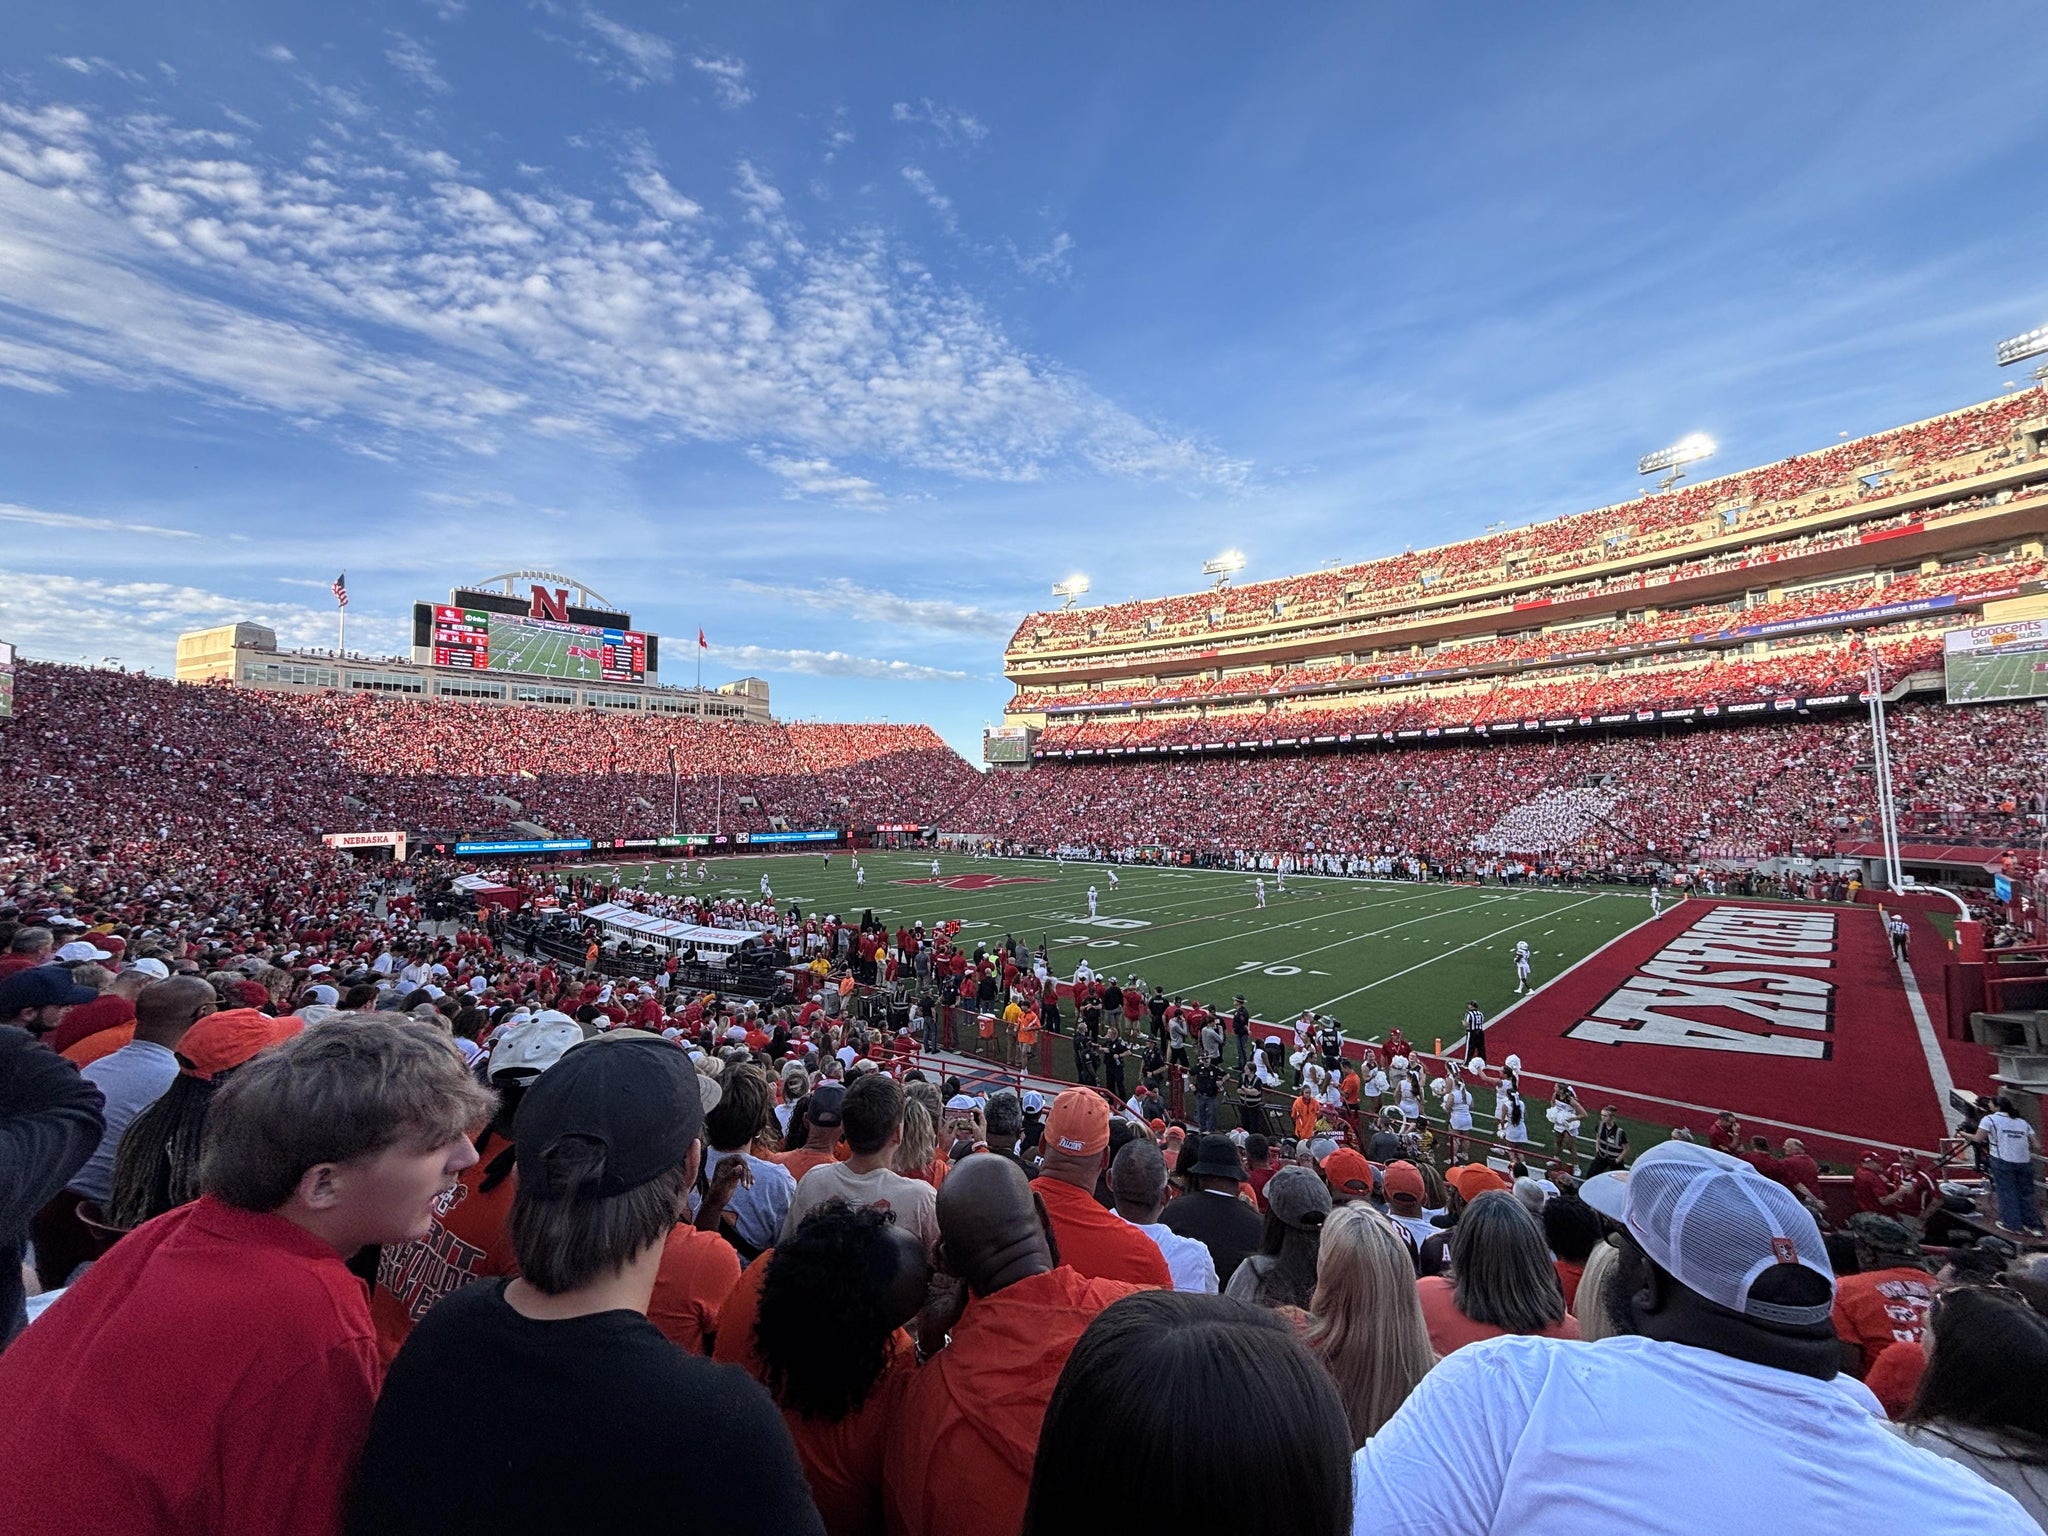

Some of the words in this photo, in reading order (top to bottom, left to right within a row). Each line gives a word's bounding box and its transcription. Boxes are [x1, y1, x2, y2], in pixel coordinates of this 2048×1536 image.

[1551, 592, 1590, 604] NATION
[1594, 582, 1641, 597] LEADING
[1676, 562, 1742, 580] ACADEMIC
[1748, 556, 1771, 567] ALL
[1777, 538, 1861, 561] AMERICANS
[529, 584, 569, 622] N
[1761, 623, 1795, 633] SERVING
[1796, 616, 1839, 628] NEBRASKA
[1840, 610, 1880, 621] FAMILIES
[1880, 605, 1908, 616] SINCE
[1972, 637, 1990, 646] deli
[2018, 630, 2042, 640] subs
[1599, 714, 1630, 722] KICKOFF
[1661, 708, 1696, 717] KICKOFF
[1728, 702, 1767, 712] KICKOFF
[1805, 695, 1849, 706] KICKOFF
[343, 835, 389, 845] NEBRASKA
[945, 920, 961, 935] 305
[1234, 961, 1303, 976] 10
[1562, 906, 1837, 1060] NEBRASKA
